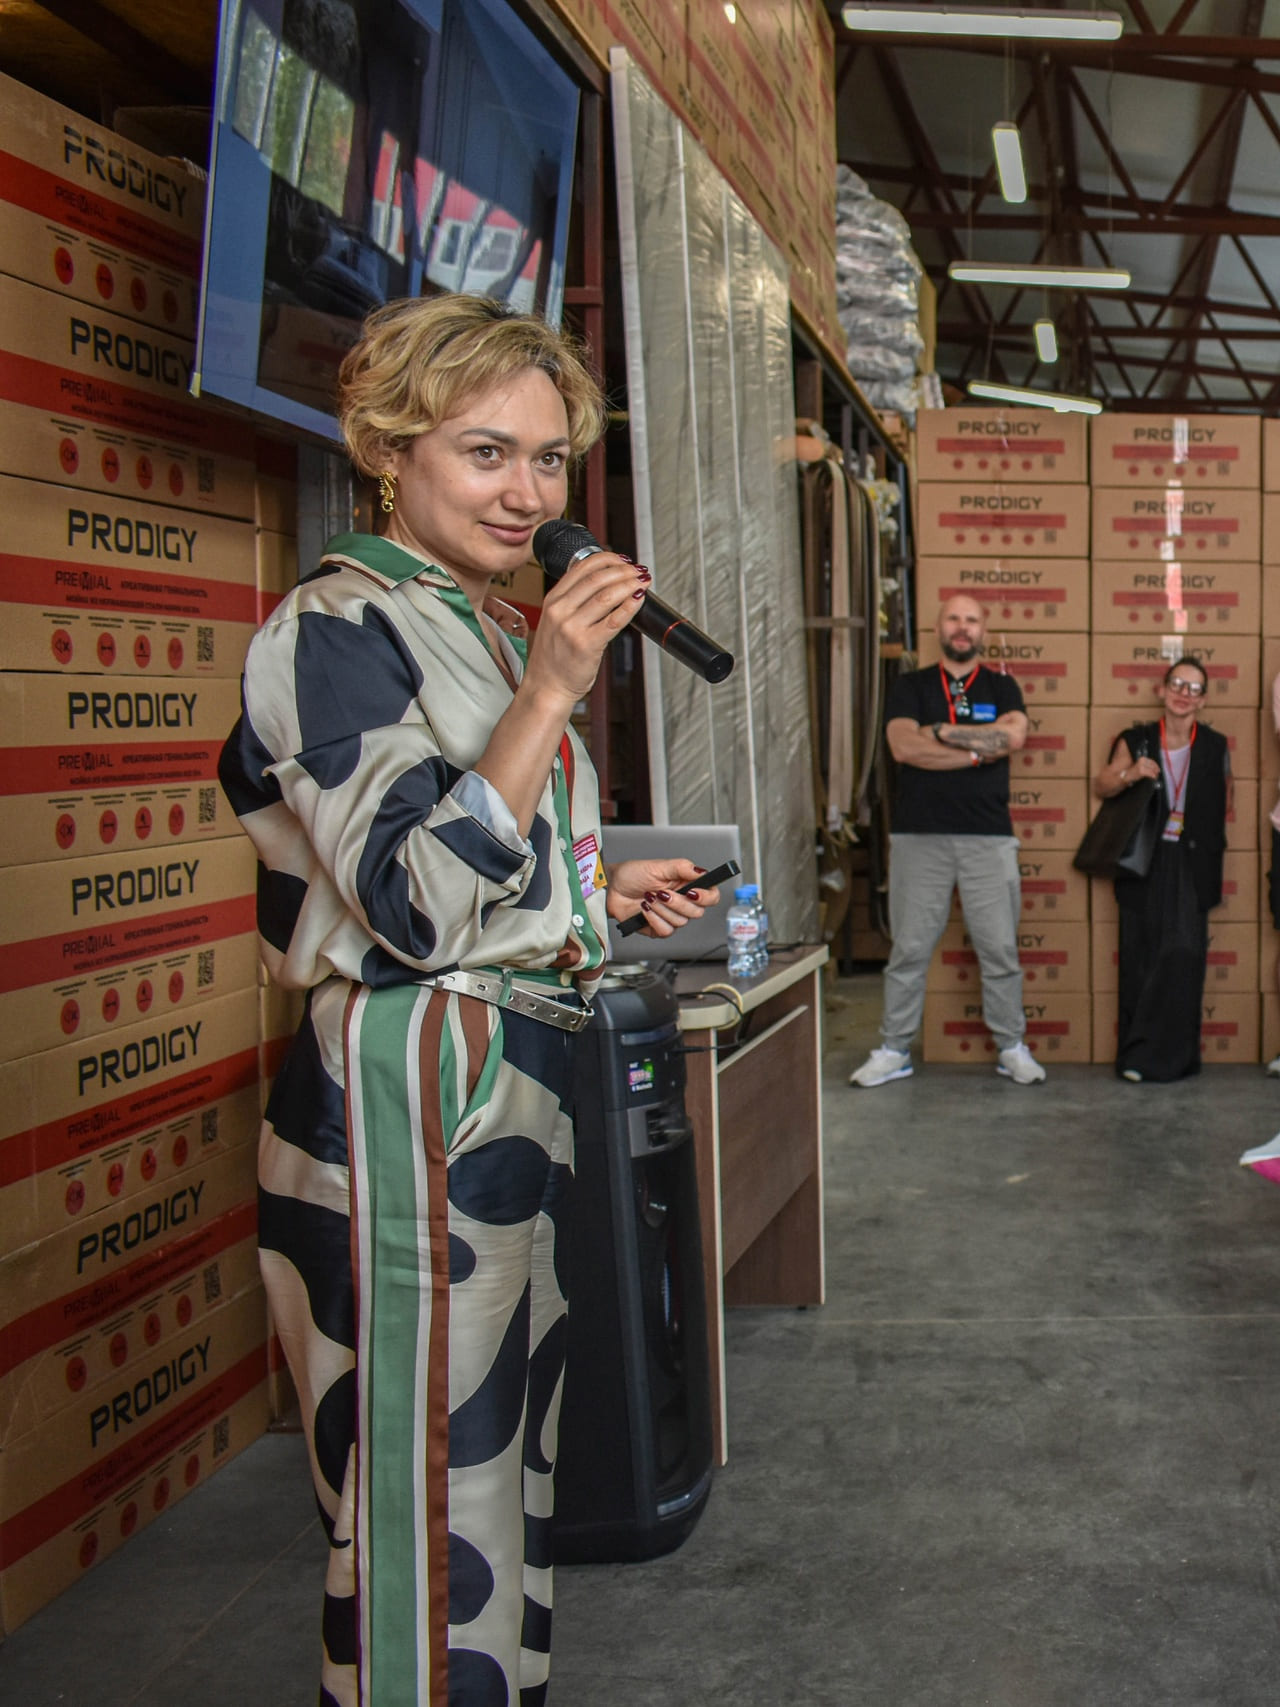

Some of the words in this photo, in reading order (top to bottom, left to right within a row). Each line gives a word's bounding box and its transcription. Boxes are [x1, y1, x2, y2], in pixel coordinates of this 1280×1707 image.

[64, 125, 187, 218] PRODIGY
[958, 421, 1041, 436] PRODIGY
[959, 495, 1042, 510] PRODIGY
[68, 508, 197, 563] PRODIGY
[959, 570, 1042, 585] PRODIGY
[977, 644, 1043, 659] RODIGY
[68, 692, 198, 729] PRODIGY
[72, 859, 200, 916] PRODIGY
[78, 1020, 202, 1096] PRODIGY
[77, 1180, 204, 1274] PRODIGY
[90, 1336, 211, 1448] PRODIGY
